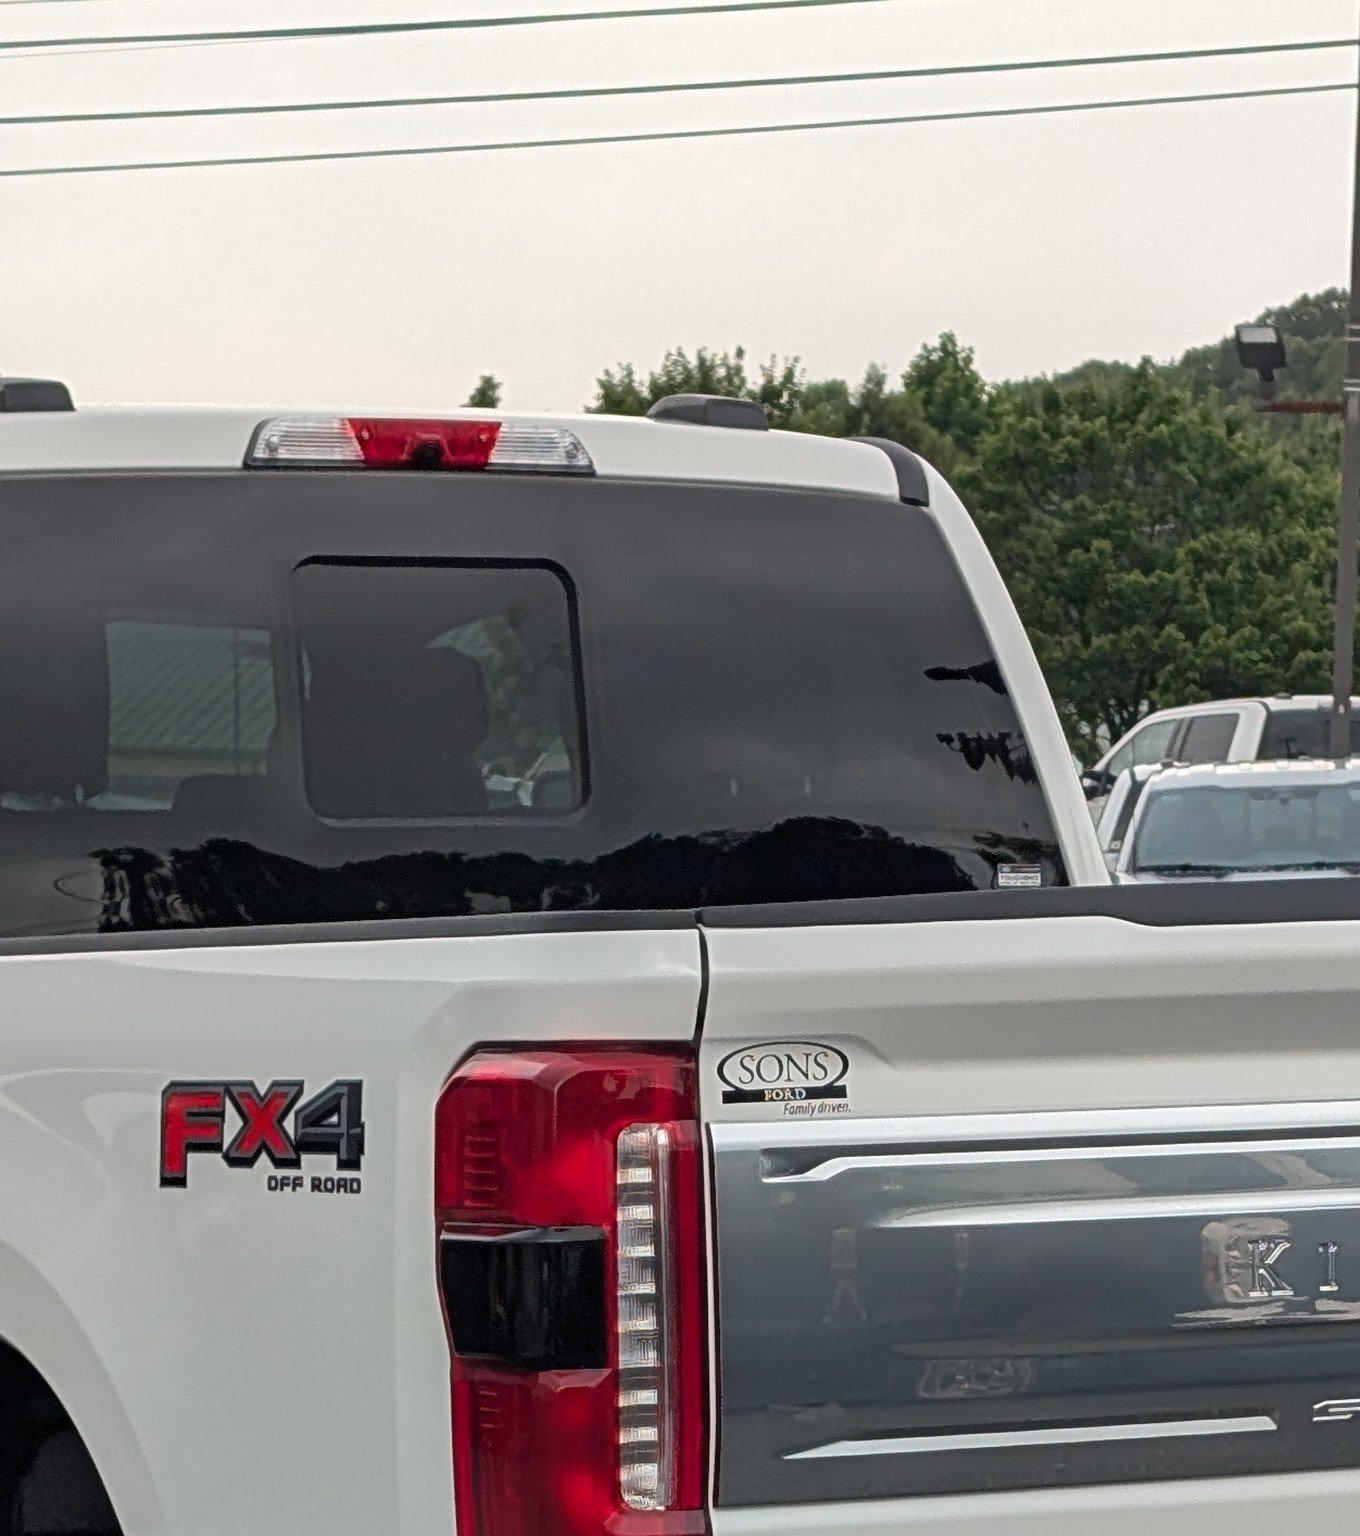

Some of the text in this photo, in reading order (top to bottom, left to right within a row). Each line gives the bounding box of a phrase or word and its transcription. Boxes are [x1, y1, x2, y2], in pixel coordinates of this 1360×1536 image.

[738, 1051, 829, 1084] SONS
[764, 1088, 807, 1100] FORD
[783, 1101, 851, 1117] Family driven.
[159, 1079, 364, 1188] FX4
[267, 1175, 361, 1194] OFF ROAD
